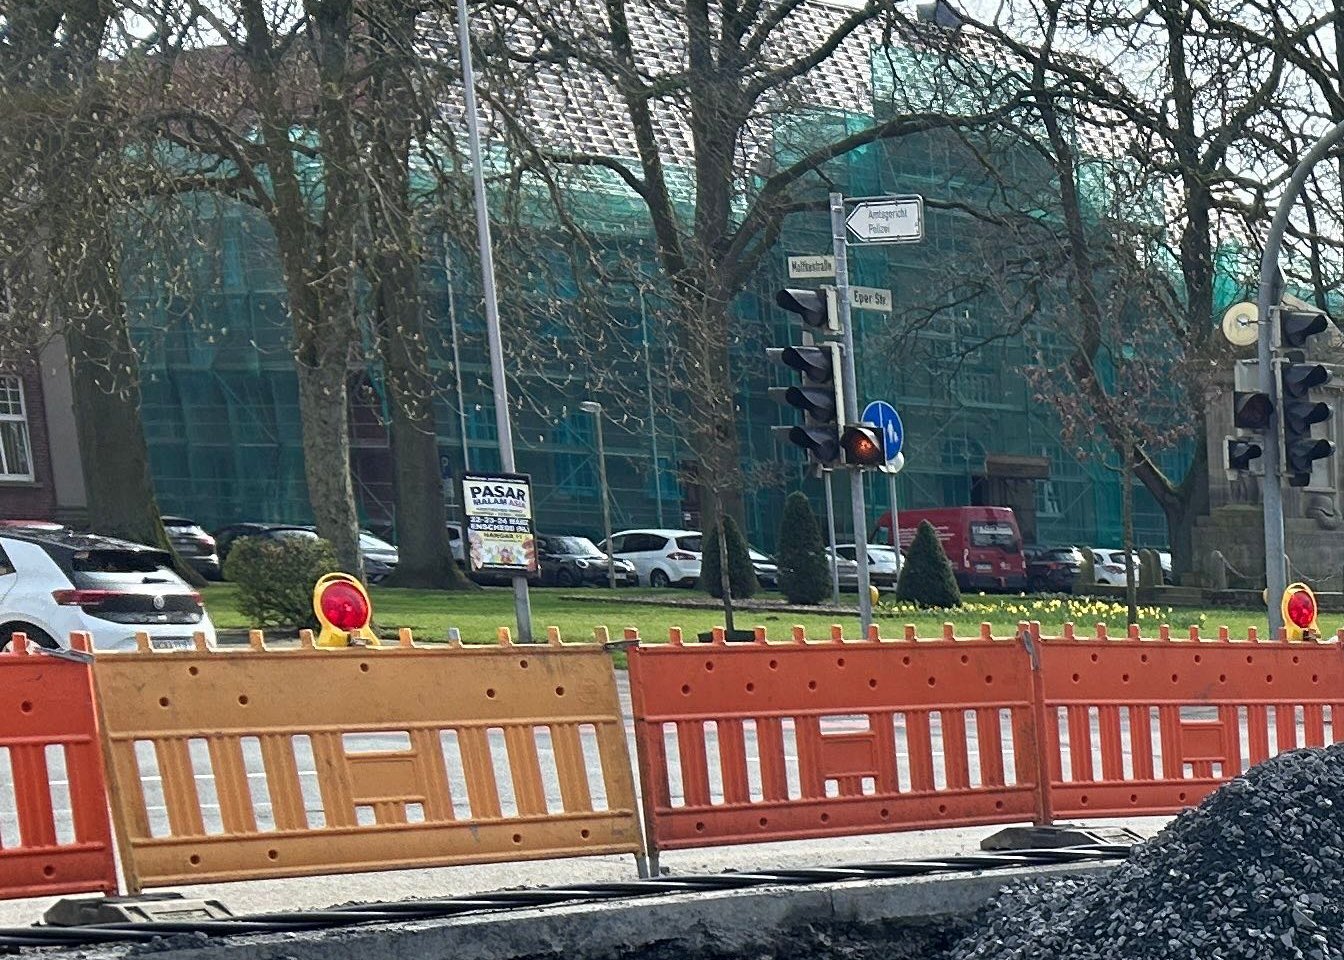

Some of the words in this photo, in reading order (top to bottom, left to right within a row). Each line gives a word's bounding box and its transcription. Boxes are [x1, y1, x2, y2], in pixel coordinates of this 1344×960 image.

[868, 223, 890, 234] Polizei
[853, 290, 873, 305] Eper
[469, 486, 525, 501] PASAR
